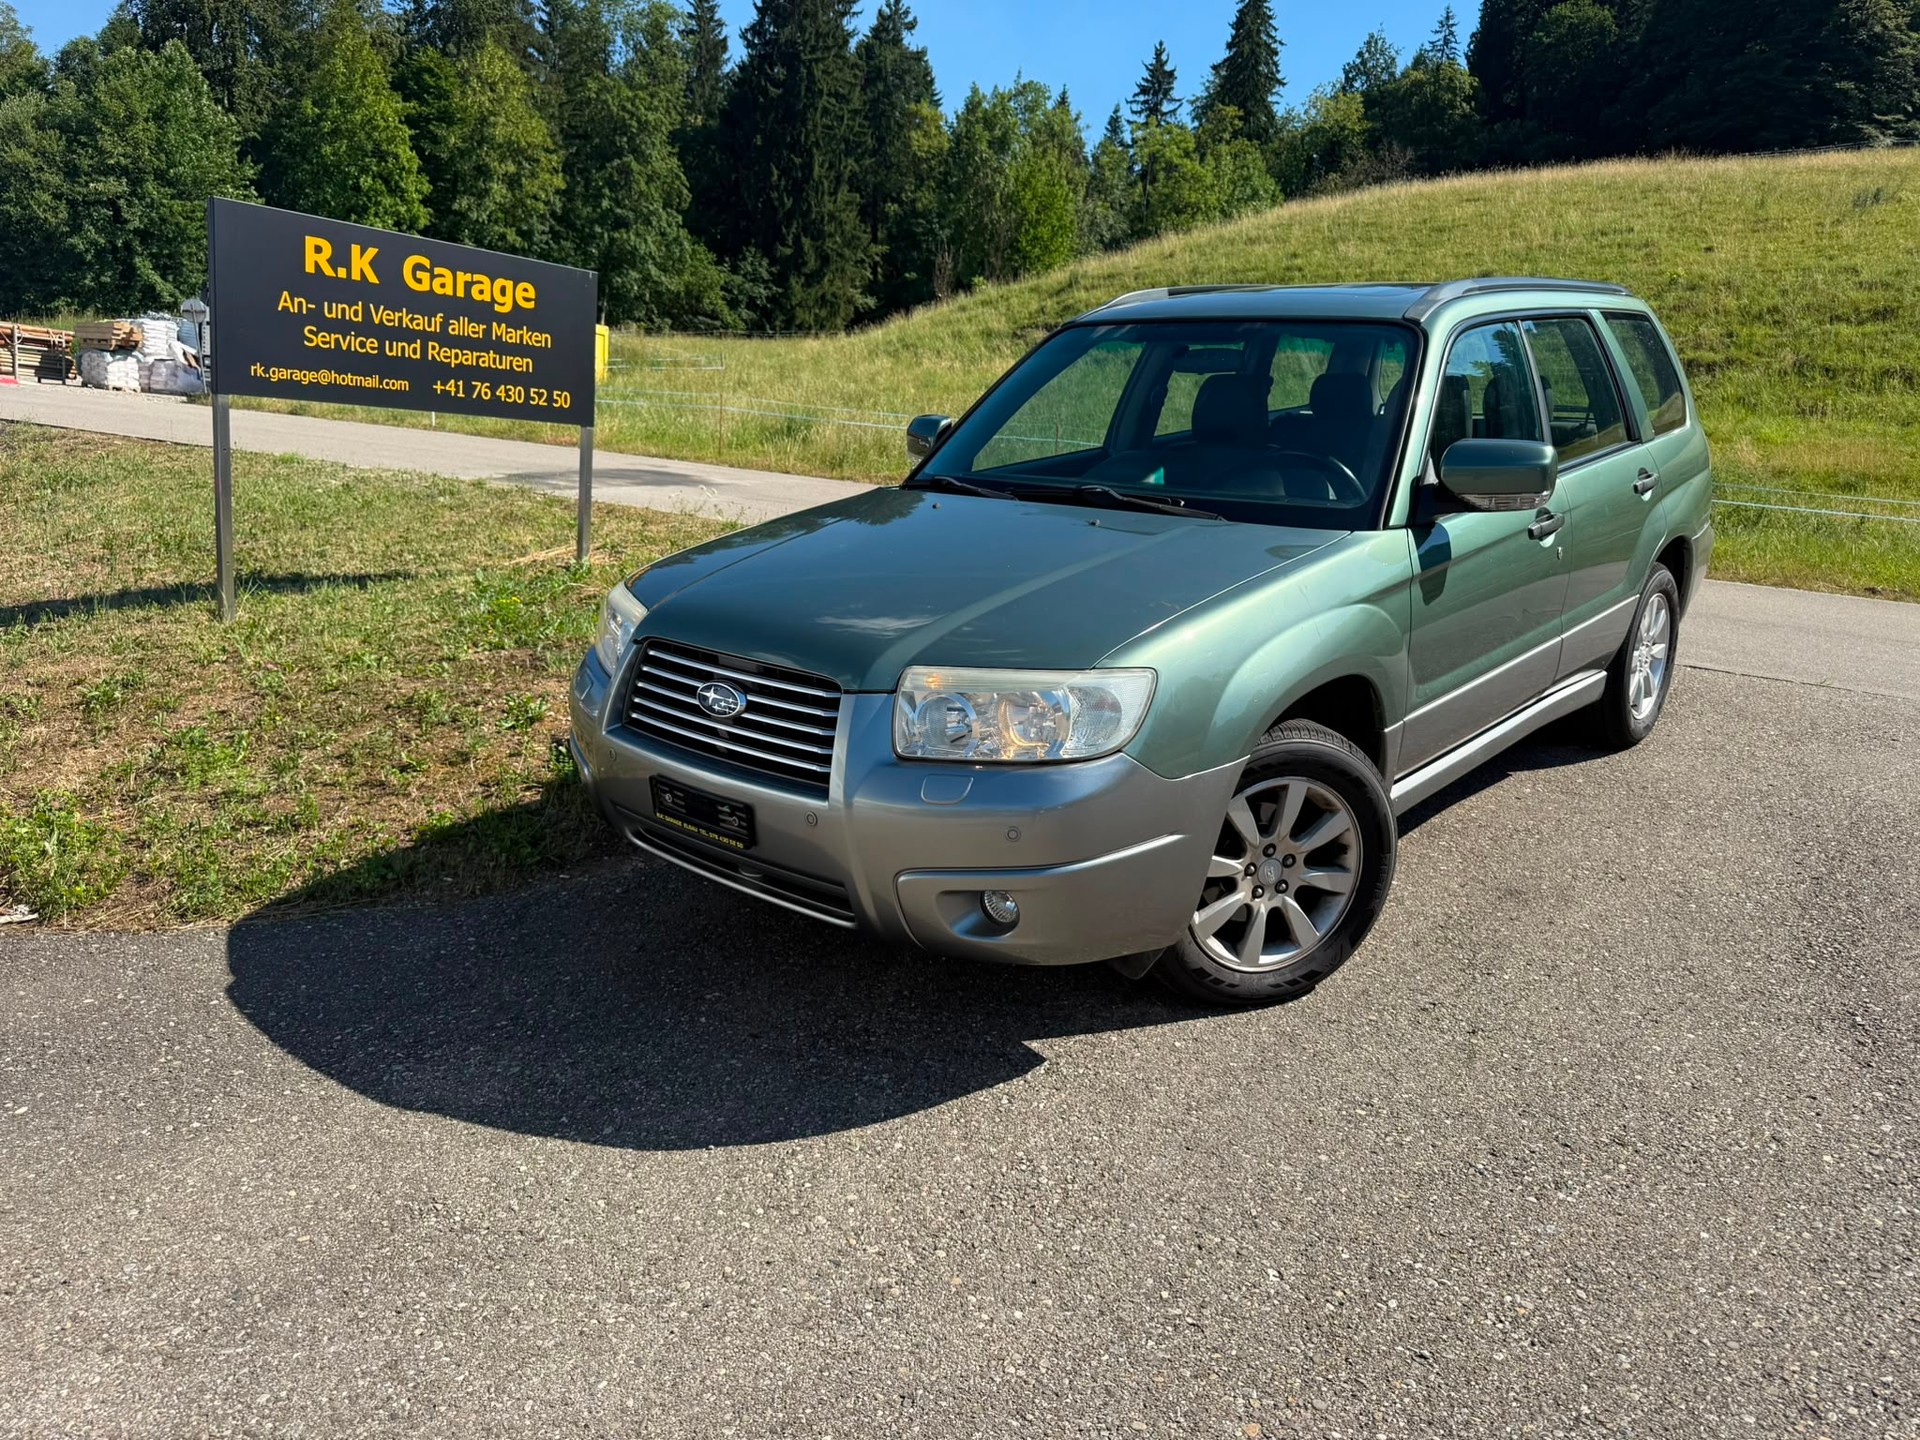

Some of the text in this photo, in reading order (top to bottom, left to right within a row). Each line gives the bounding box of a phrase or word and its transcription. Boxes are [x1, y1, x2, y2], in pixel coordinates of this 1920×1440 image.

[304, 235, 537, 314] R.K Garage
[277, 291, 552, 349] An- und Verkauf aller Marken
[303, 325, 533, 373] Service und Reparaturen
[250, 362, 410, 392] rk.garage@hotmail.com
[432, 379, 571, 409] +41 76 430 52 50
